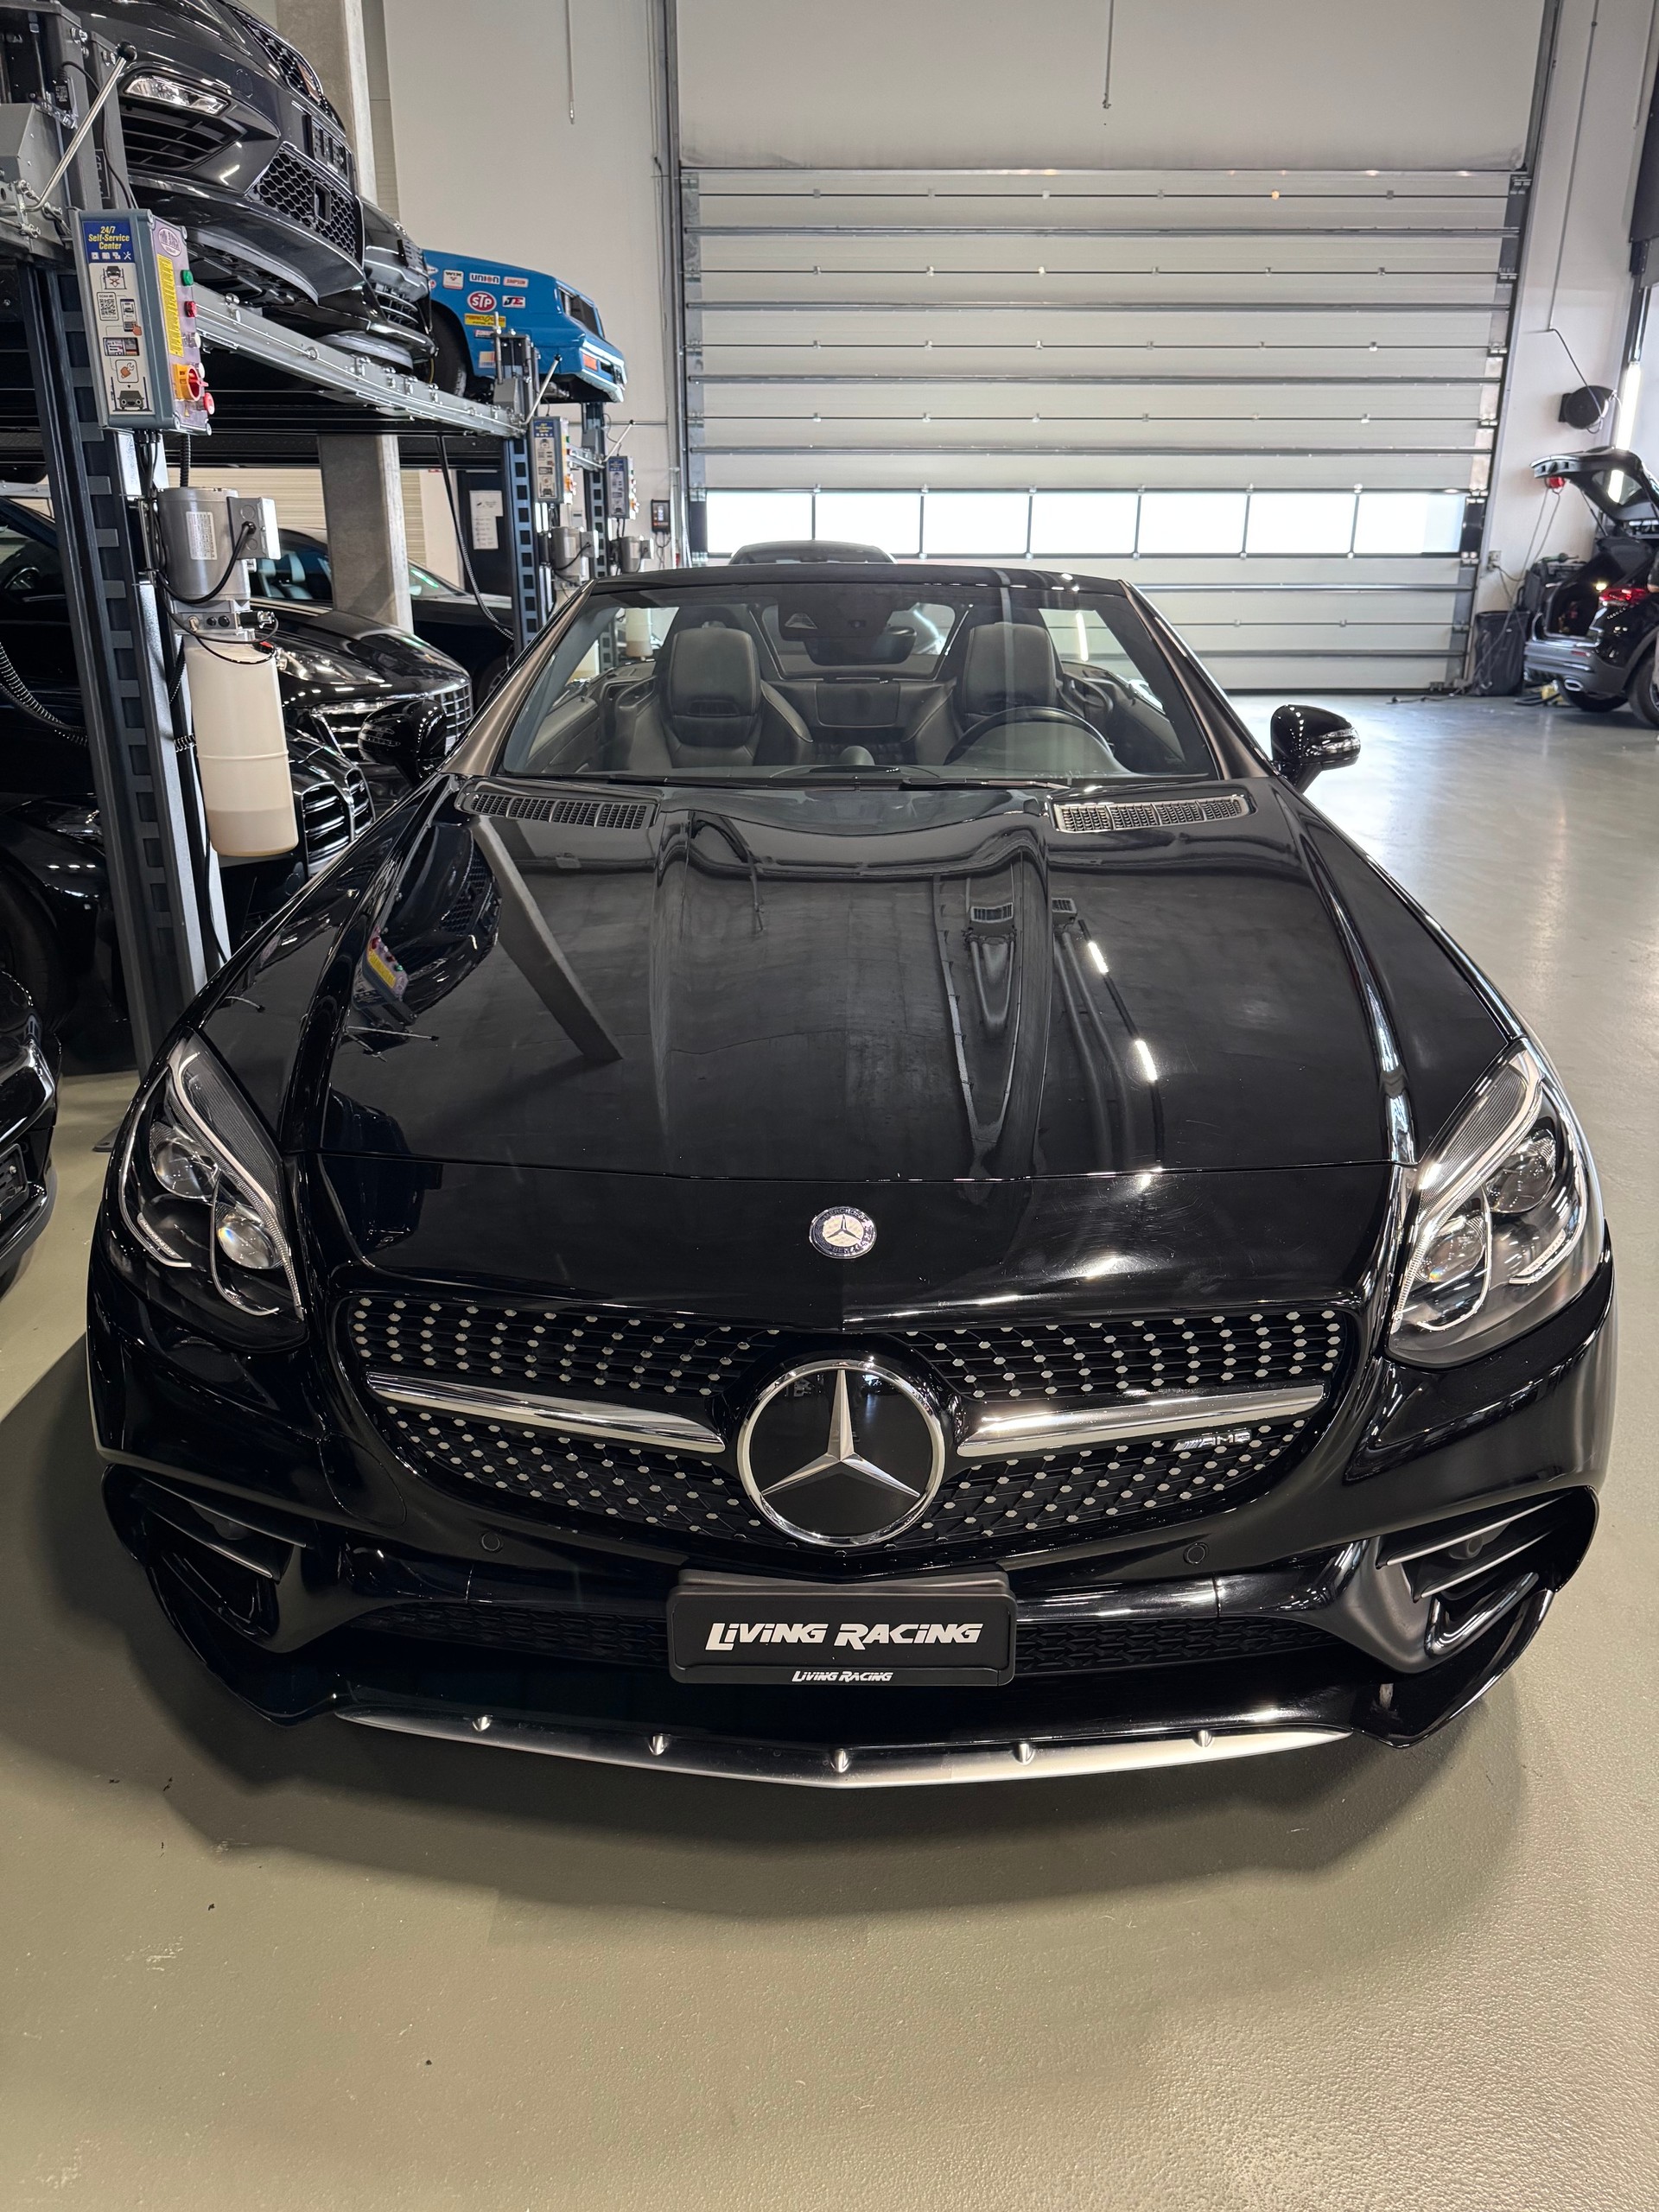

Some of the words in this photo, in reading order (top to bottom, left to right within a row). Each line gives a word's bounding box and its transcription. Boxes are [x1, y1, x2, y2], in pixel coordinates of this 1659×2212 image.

[100, 226, 116, 234] 24/7
[88, 233, 130, 242] Self-Service
[472, 294, 493, 308] STP
[504, 297, 524, 306] JE
